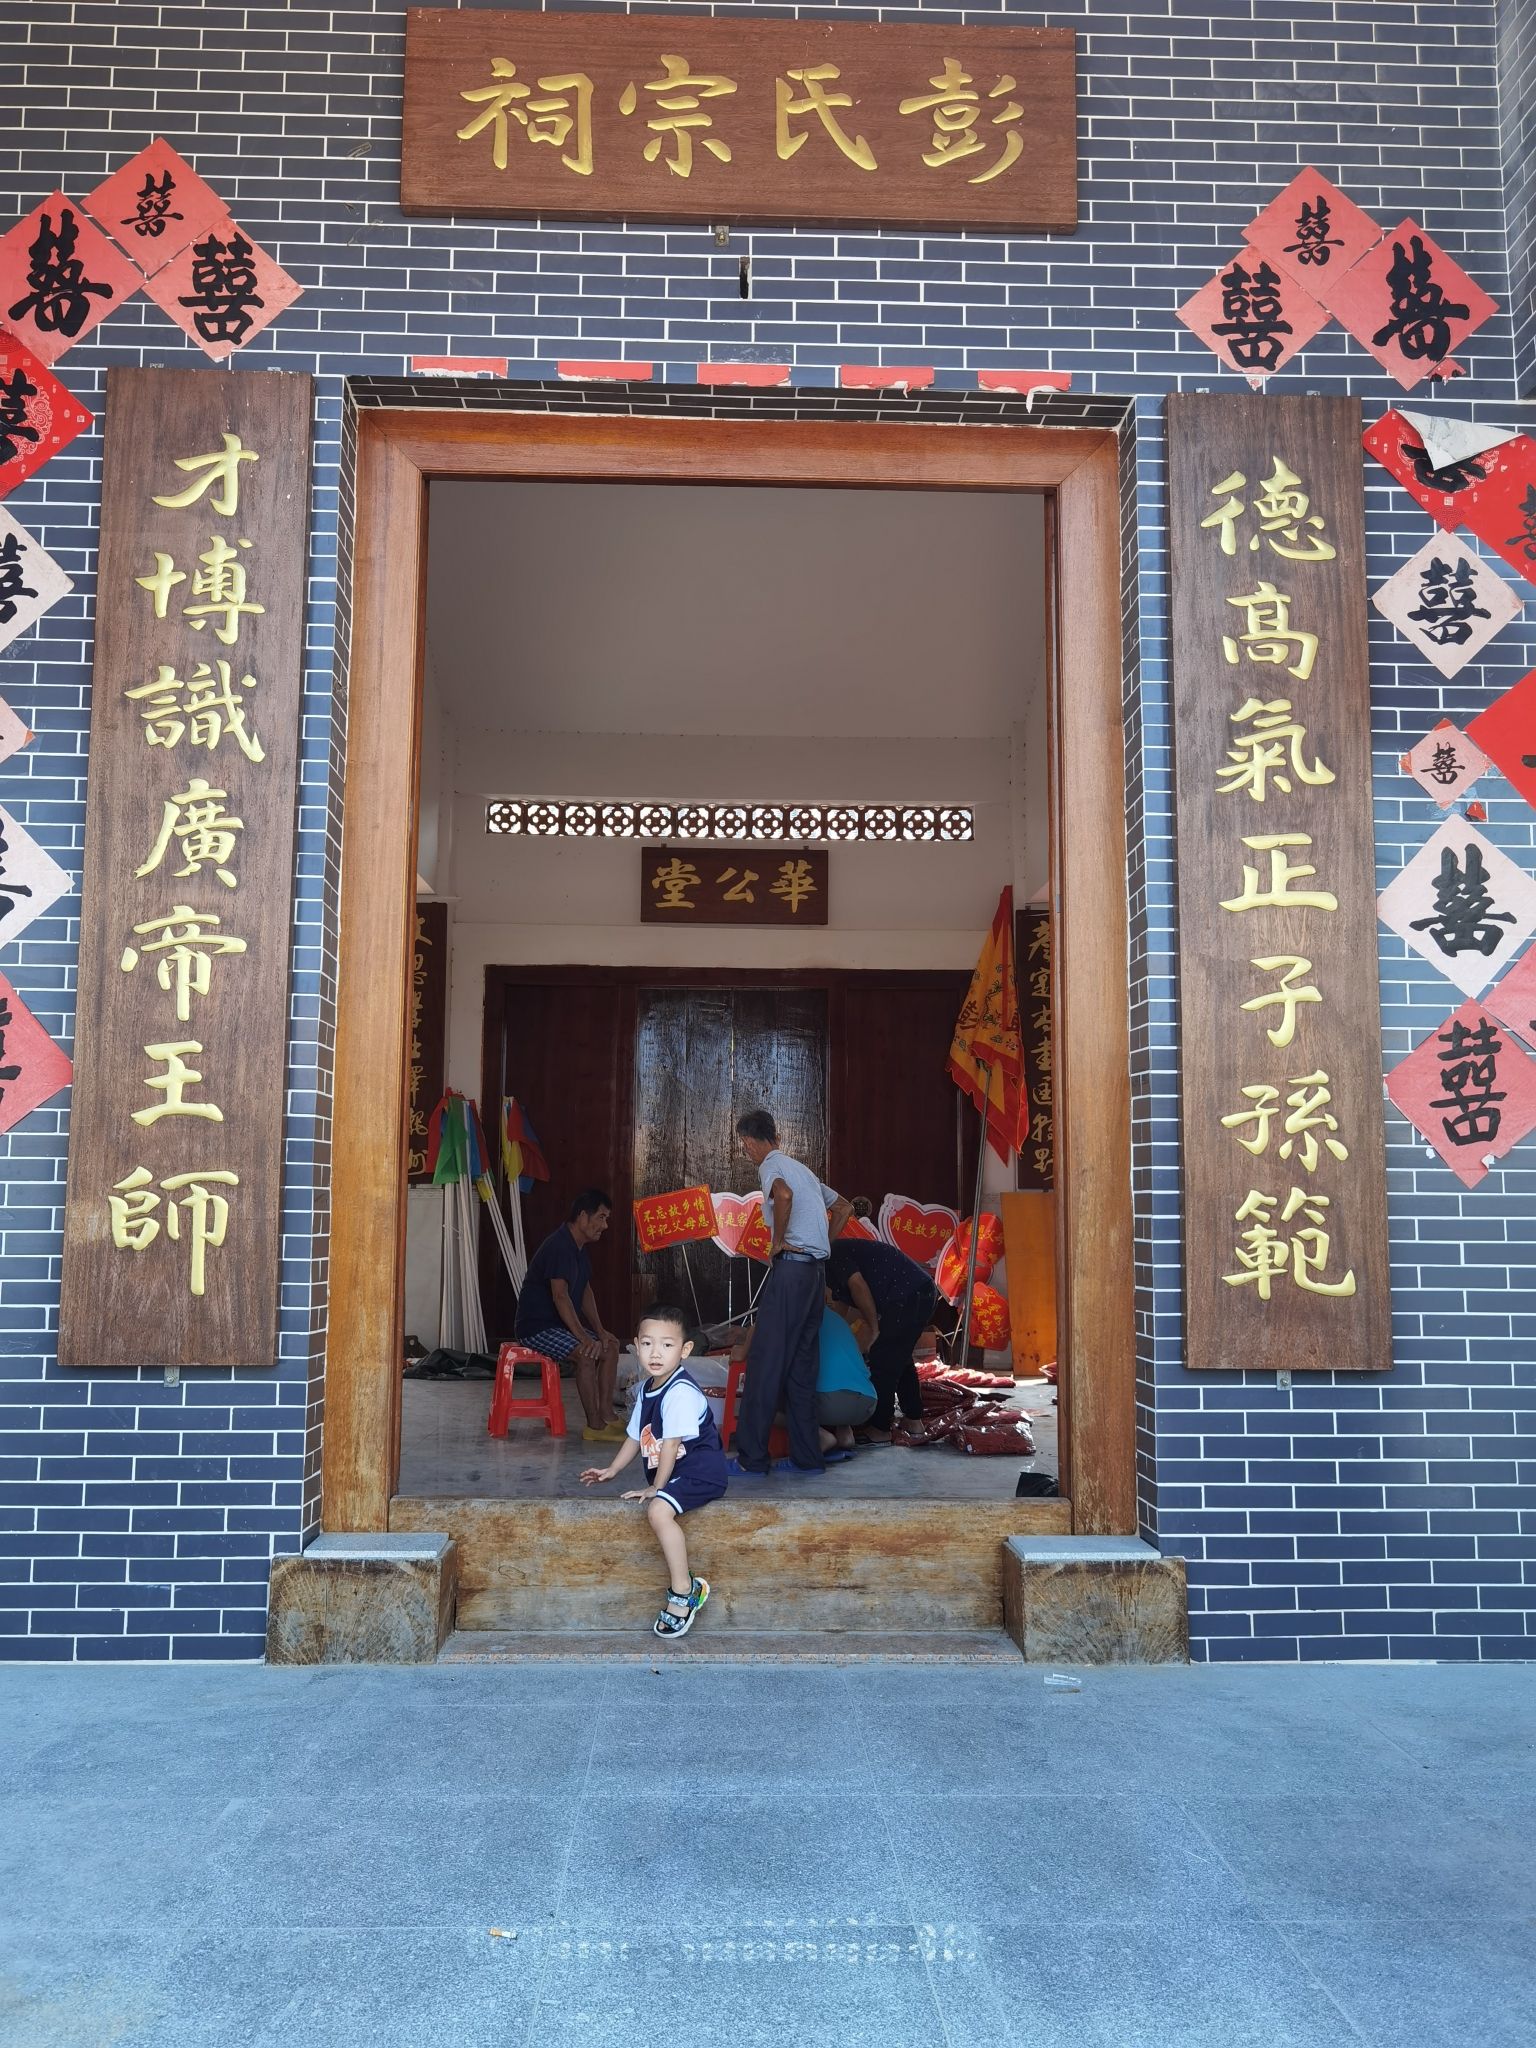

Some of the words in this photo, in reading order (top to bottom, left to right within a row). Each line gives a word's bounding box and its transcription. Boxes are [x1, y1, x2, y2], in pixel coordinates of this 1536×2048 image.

[456, 54, 1025, 184] 彭氏宗祠
[107, 432, 265, 1298] 才博識廣帝王師
[651, 857, 819, 914] 華公堂
[642, 1196, 706, 1223] 不忘故乡情
[646, 1213, 710, 1241] 牢记父母恩
[891, 1216, 952, 1240] 月是故乡明
